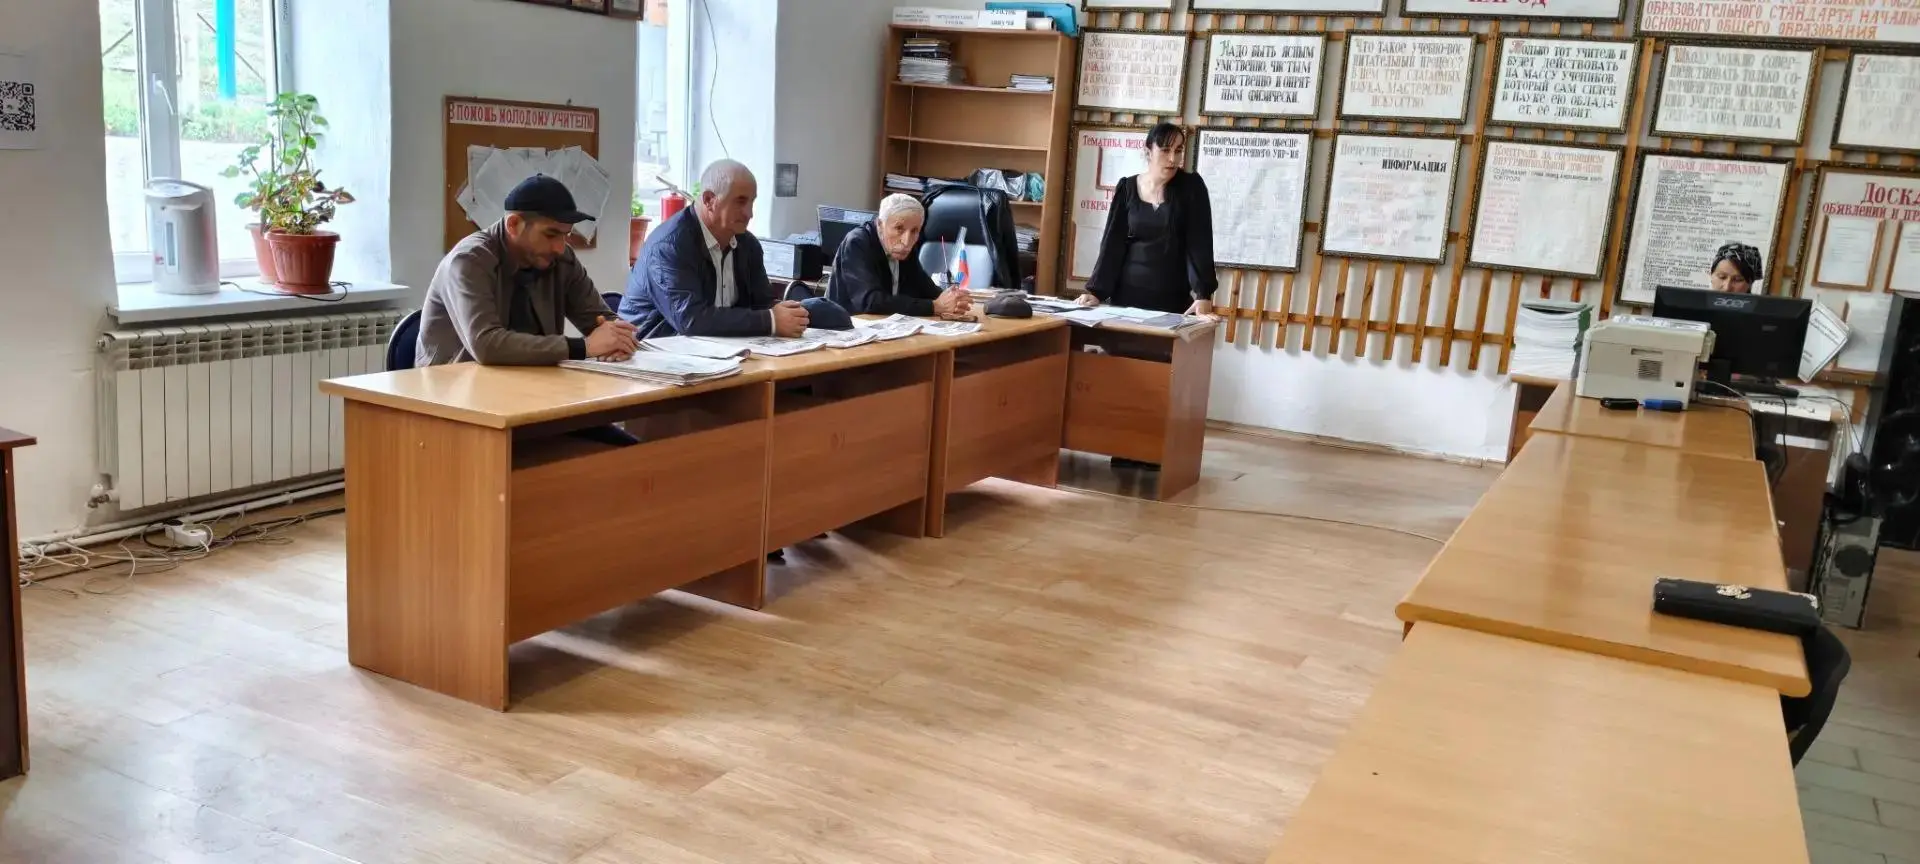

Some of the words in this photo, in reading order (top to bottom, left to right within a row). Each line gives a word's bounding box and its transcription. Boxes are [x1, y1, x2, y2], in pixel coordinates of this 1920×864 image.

[1769, 5, 1854, 22] СТАНДАРТА
[1644, 17, 1711, 33] ОСНОВНОГО
[1716, 20, 1771, 35] ОБЩЕГО
[1778, 21, 1878, 40] ОБРАЗОВАНИЯ
[1219, 40, 1248, 58] НАДО
[1251, 45, 1277, 58] БЫТЬ
[1281, 45, 1315, 59] ЯСНЫМ
[1555, 46, 1572, 57] ТОТ
[1576, 47, 1617, 60] УЧИТЕЛЬ
[1619, 49, 1628, 61] И
[1270, 60, 1312, 73] ЧИСТЫМ
[1506, 55, 1535, 69] БУДЕТ
[1542, 57, 1619, 72] ДЕЙСТВОВАТЬ
[1213, 74, 1272, 87] НРАВСТВЕННО
[1275, 76, 1283, 88] И
[1505, 67, 1518, 79] НА
[1523, 69, 1556, 81] МАССУ
[1221, 89, 1243, 101] НЫМ
[1503, 79, 1549, 93] КОТОРЫЙ
[1554, 83, 1577, 94] САМ
[1582, 84, 1617, 97] СИЛЕН
[1512, 91, 1546, 104] НАУКЕ
[456, 104, 497, 122] ПОМОЩЬ
[499, 106, 550, 127] МОЛОДОМУ
[551, 109, 594, 130] УЧИТЕЛЮ
[1381, 158, 1448, 173] ИНФОРМАЦИЯ
[1891, 207, 1900, 220] И
[1713, 297, 1751, 309] acer
